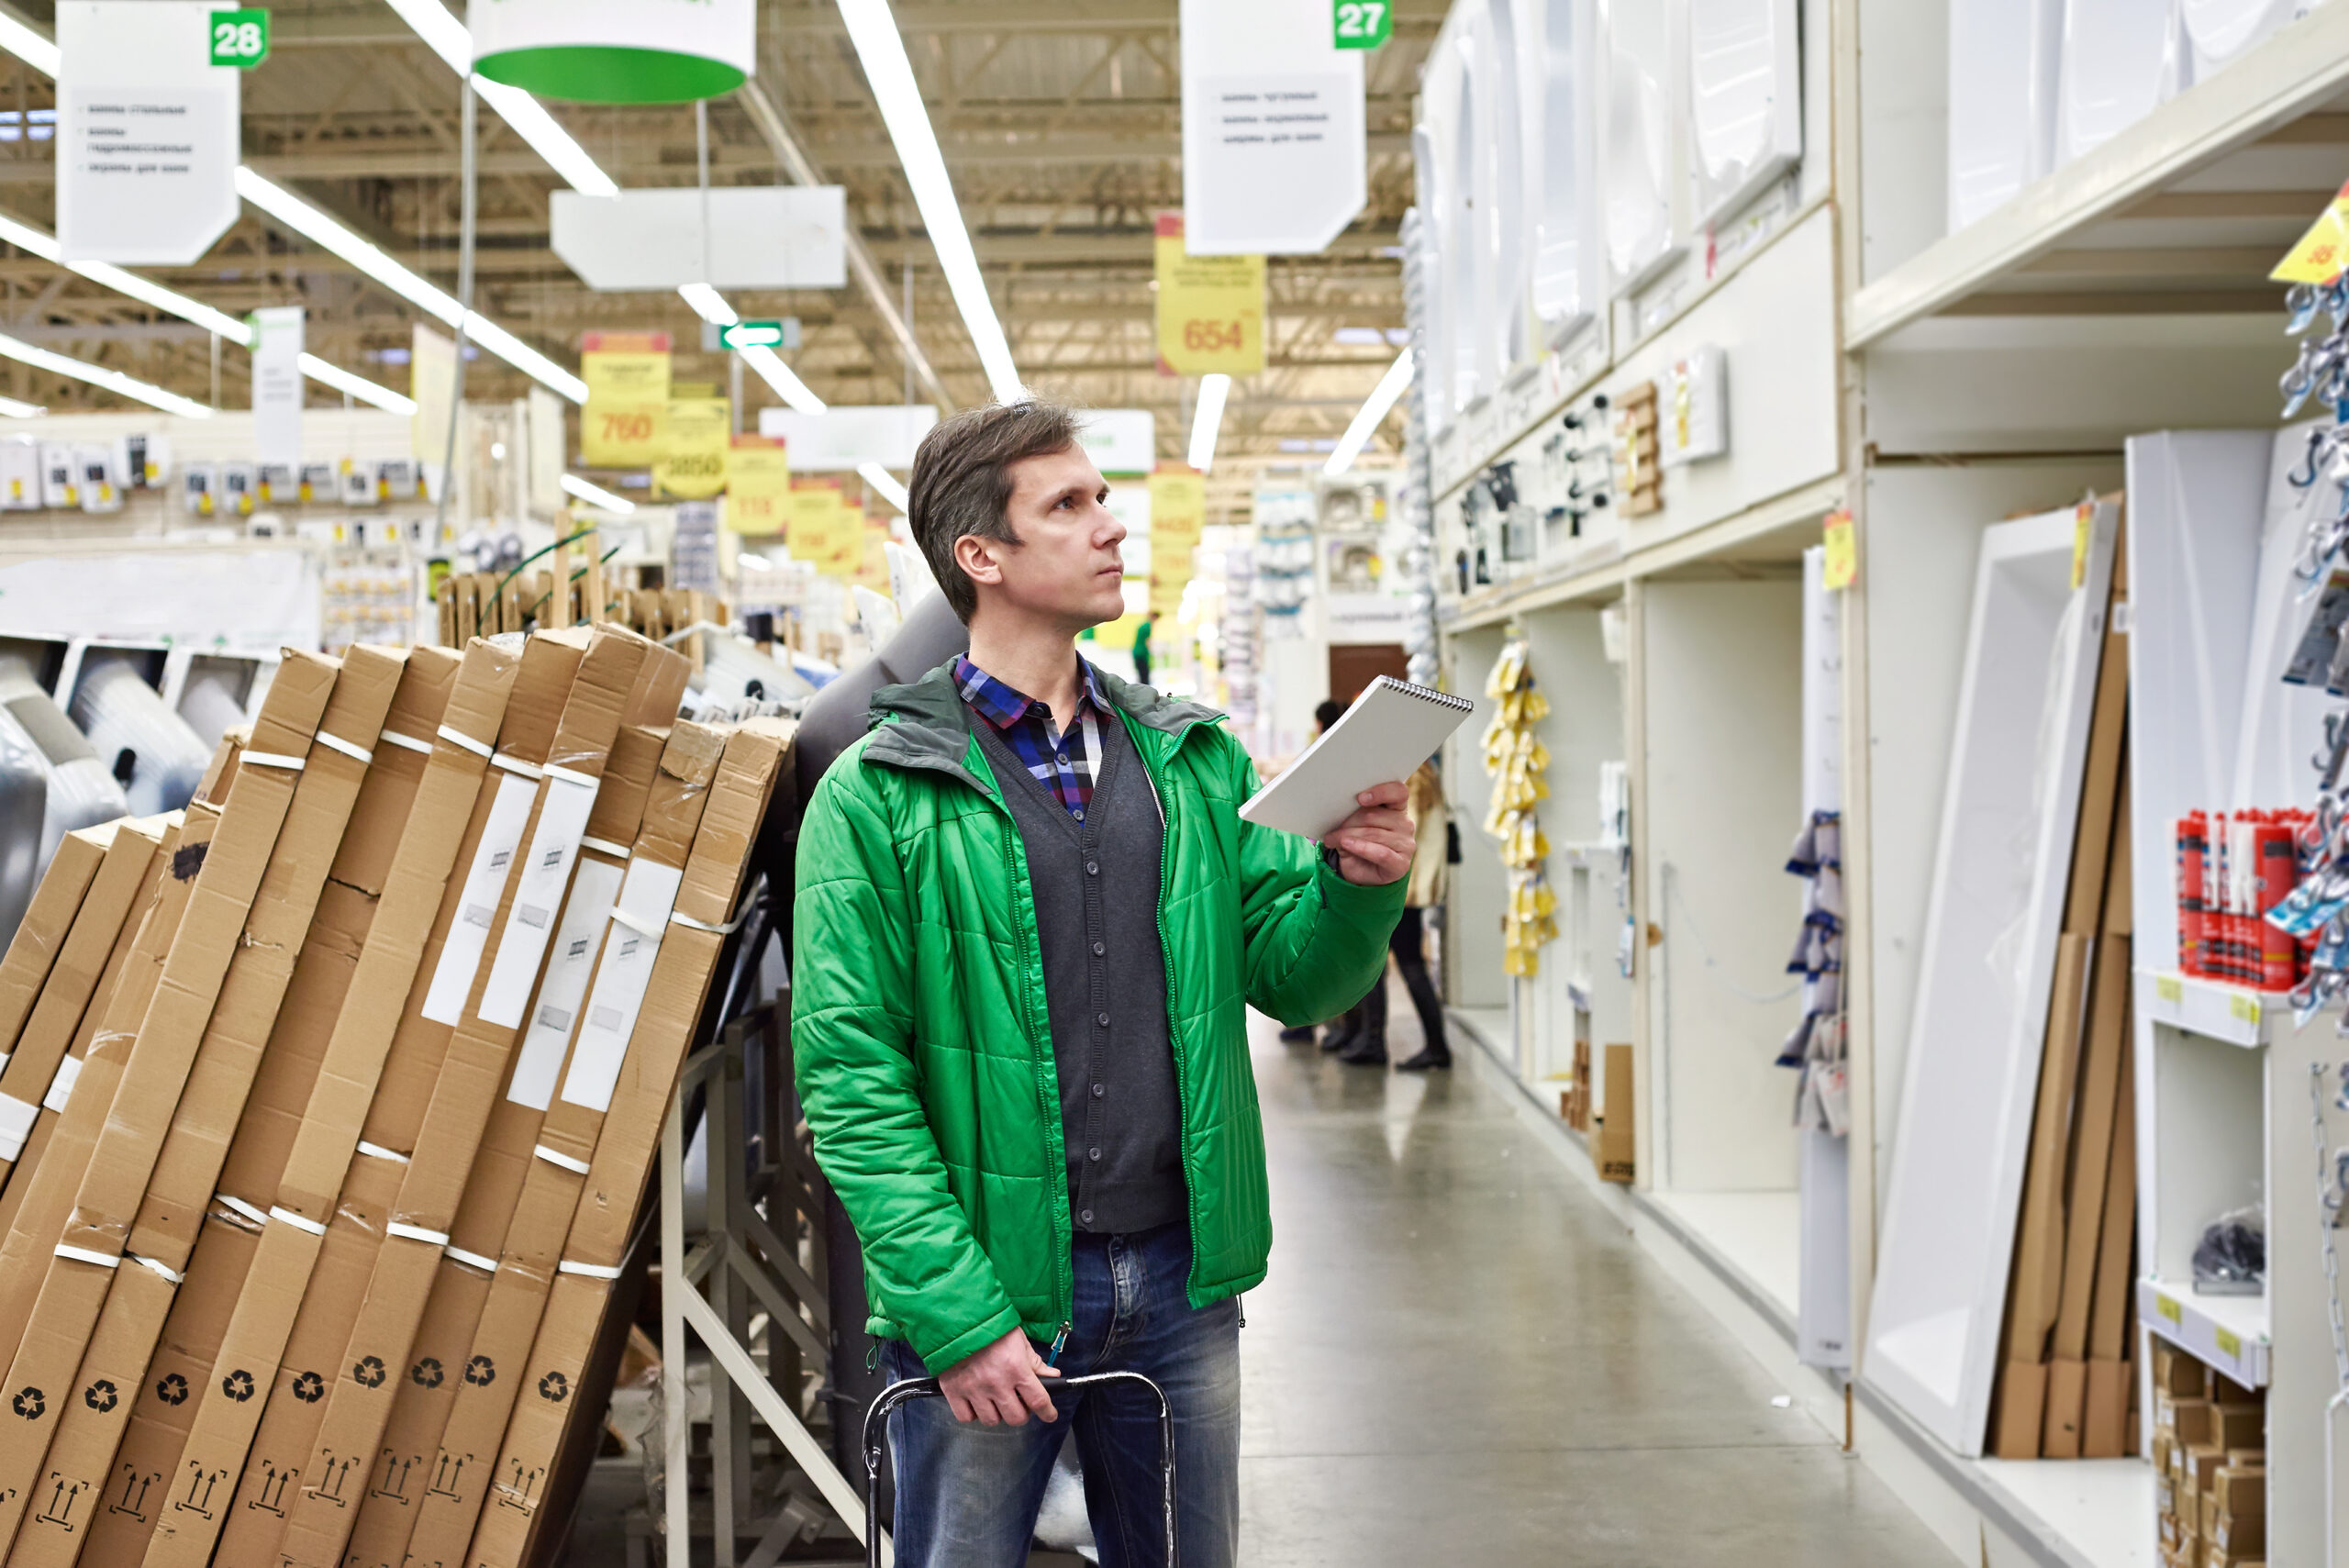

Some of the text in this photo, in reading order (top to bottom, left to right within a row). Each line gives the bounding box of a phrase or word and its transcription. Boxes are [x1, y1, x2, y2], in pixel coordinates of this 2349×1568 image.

[1337, 3, 1386, 37] 27
[214, 22, 263, 57] 28
[1184, 319, 1242, 351] 654
